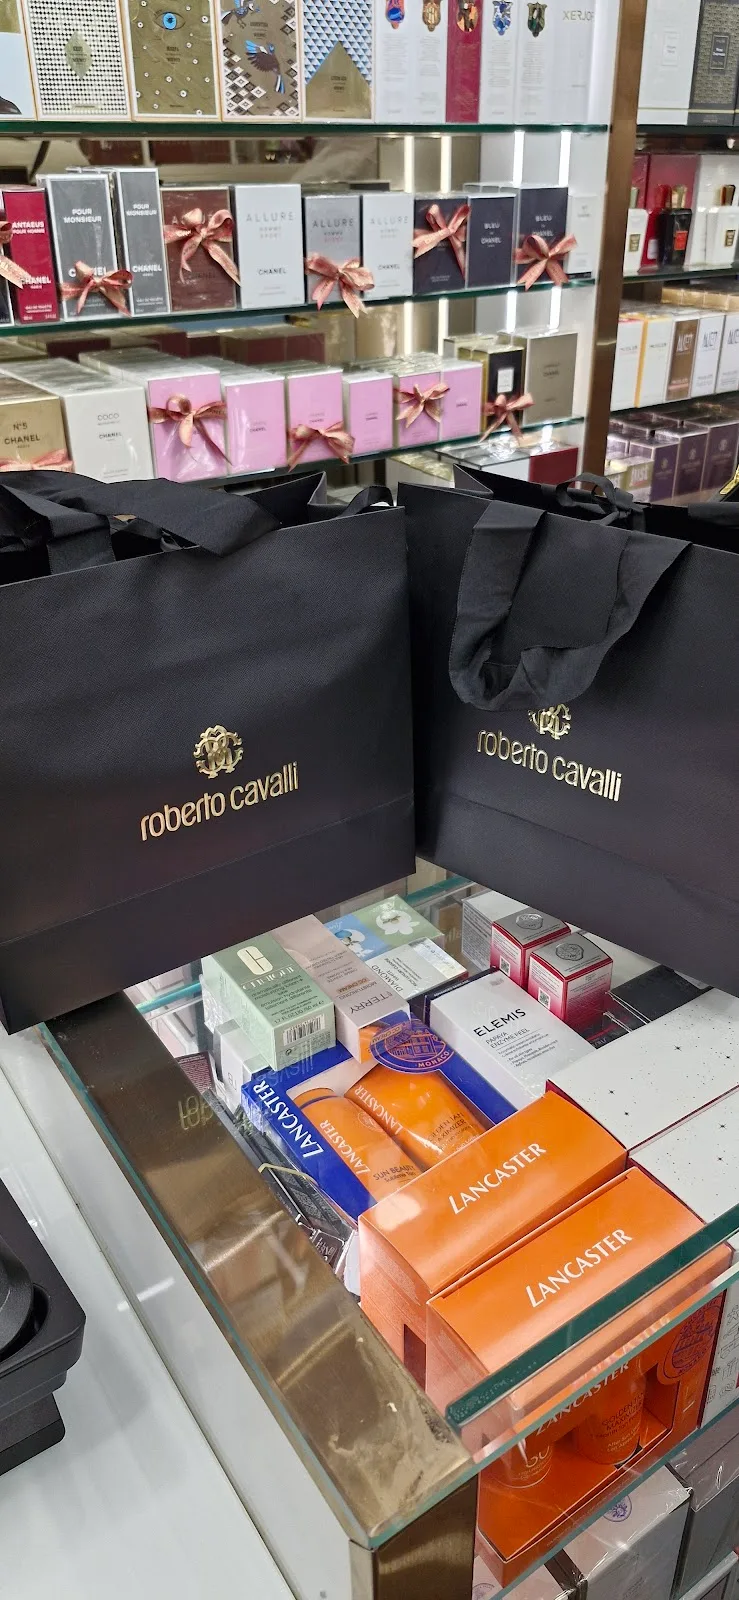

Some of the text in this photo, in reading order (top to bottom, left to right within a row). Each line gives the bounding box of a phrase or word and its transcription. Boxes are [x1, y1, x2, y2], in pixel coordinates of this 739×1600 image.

[72, 208, 92, 216] POUR
[246, 211, 294, 222] ALLURE
[370, 216, 408, 226] ALLURE
[312, 218, 354, 228] ALLURE
[132, 264, 162, 273] CHANEL
[258, 268, 287, 276] CHANEL
[21, 276, 51, 285] HANEL
[97, 412, 119, 421] COCO
[4, 434, 40, 445] CHANEL
[477, 729, 622, 802] roberto cavalli
[140, 761, 299, 841] roberto cavalli
[243, 966, 295, 990] CLINIQUE
[371, 964, 403, 992] DIAMOND
[349, 991, 386, 1014] TERRY
[473, 1008, 526, 1037] ELEMIS
[486, 1031, 509, 1045] PAPAYA
[490, 1034, 515, 1049] ENZYME
[514, 1028, 530, 1039] PEEL
[416, 1050, 451, 1069] MONACO
[253, 1080, 325, 1158] LANCASTER
[354, 1085, 404, 1135] LANCASTER
[437, 1118, 466, 1143] AXIMIZER
[319, 1119, 371, 1175] LANCASTER
[373, 1169, 390, 1181] SUN
[448, 1142, 547, 1215] LANCASTER
[525, 1228, 633, 1308] LANCASTER
